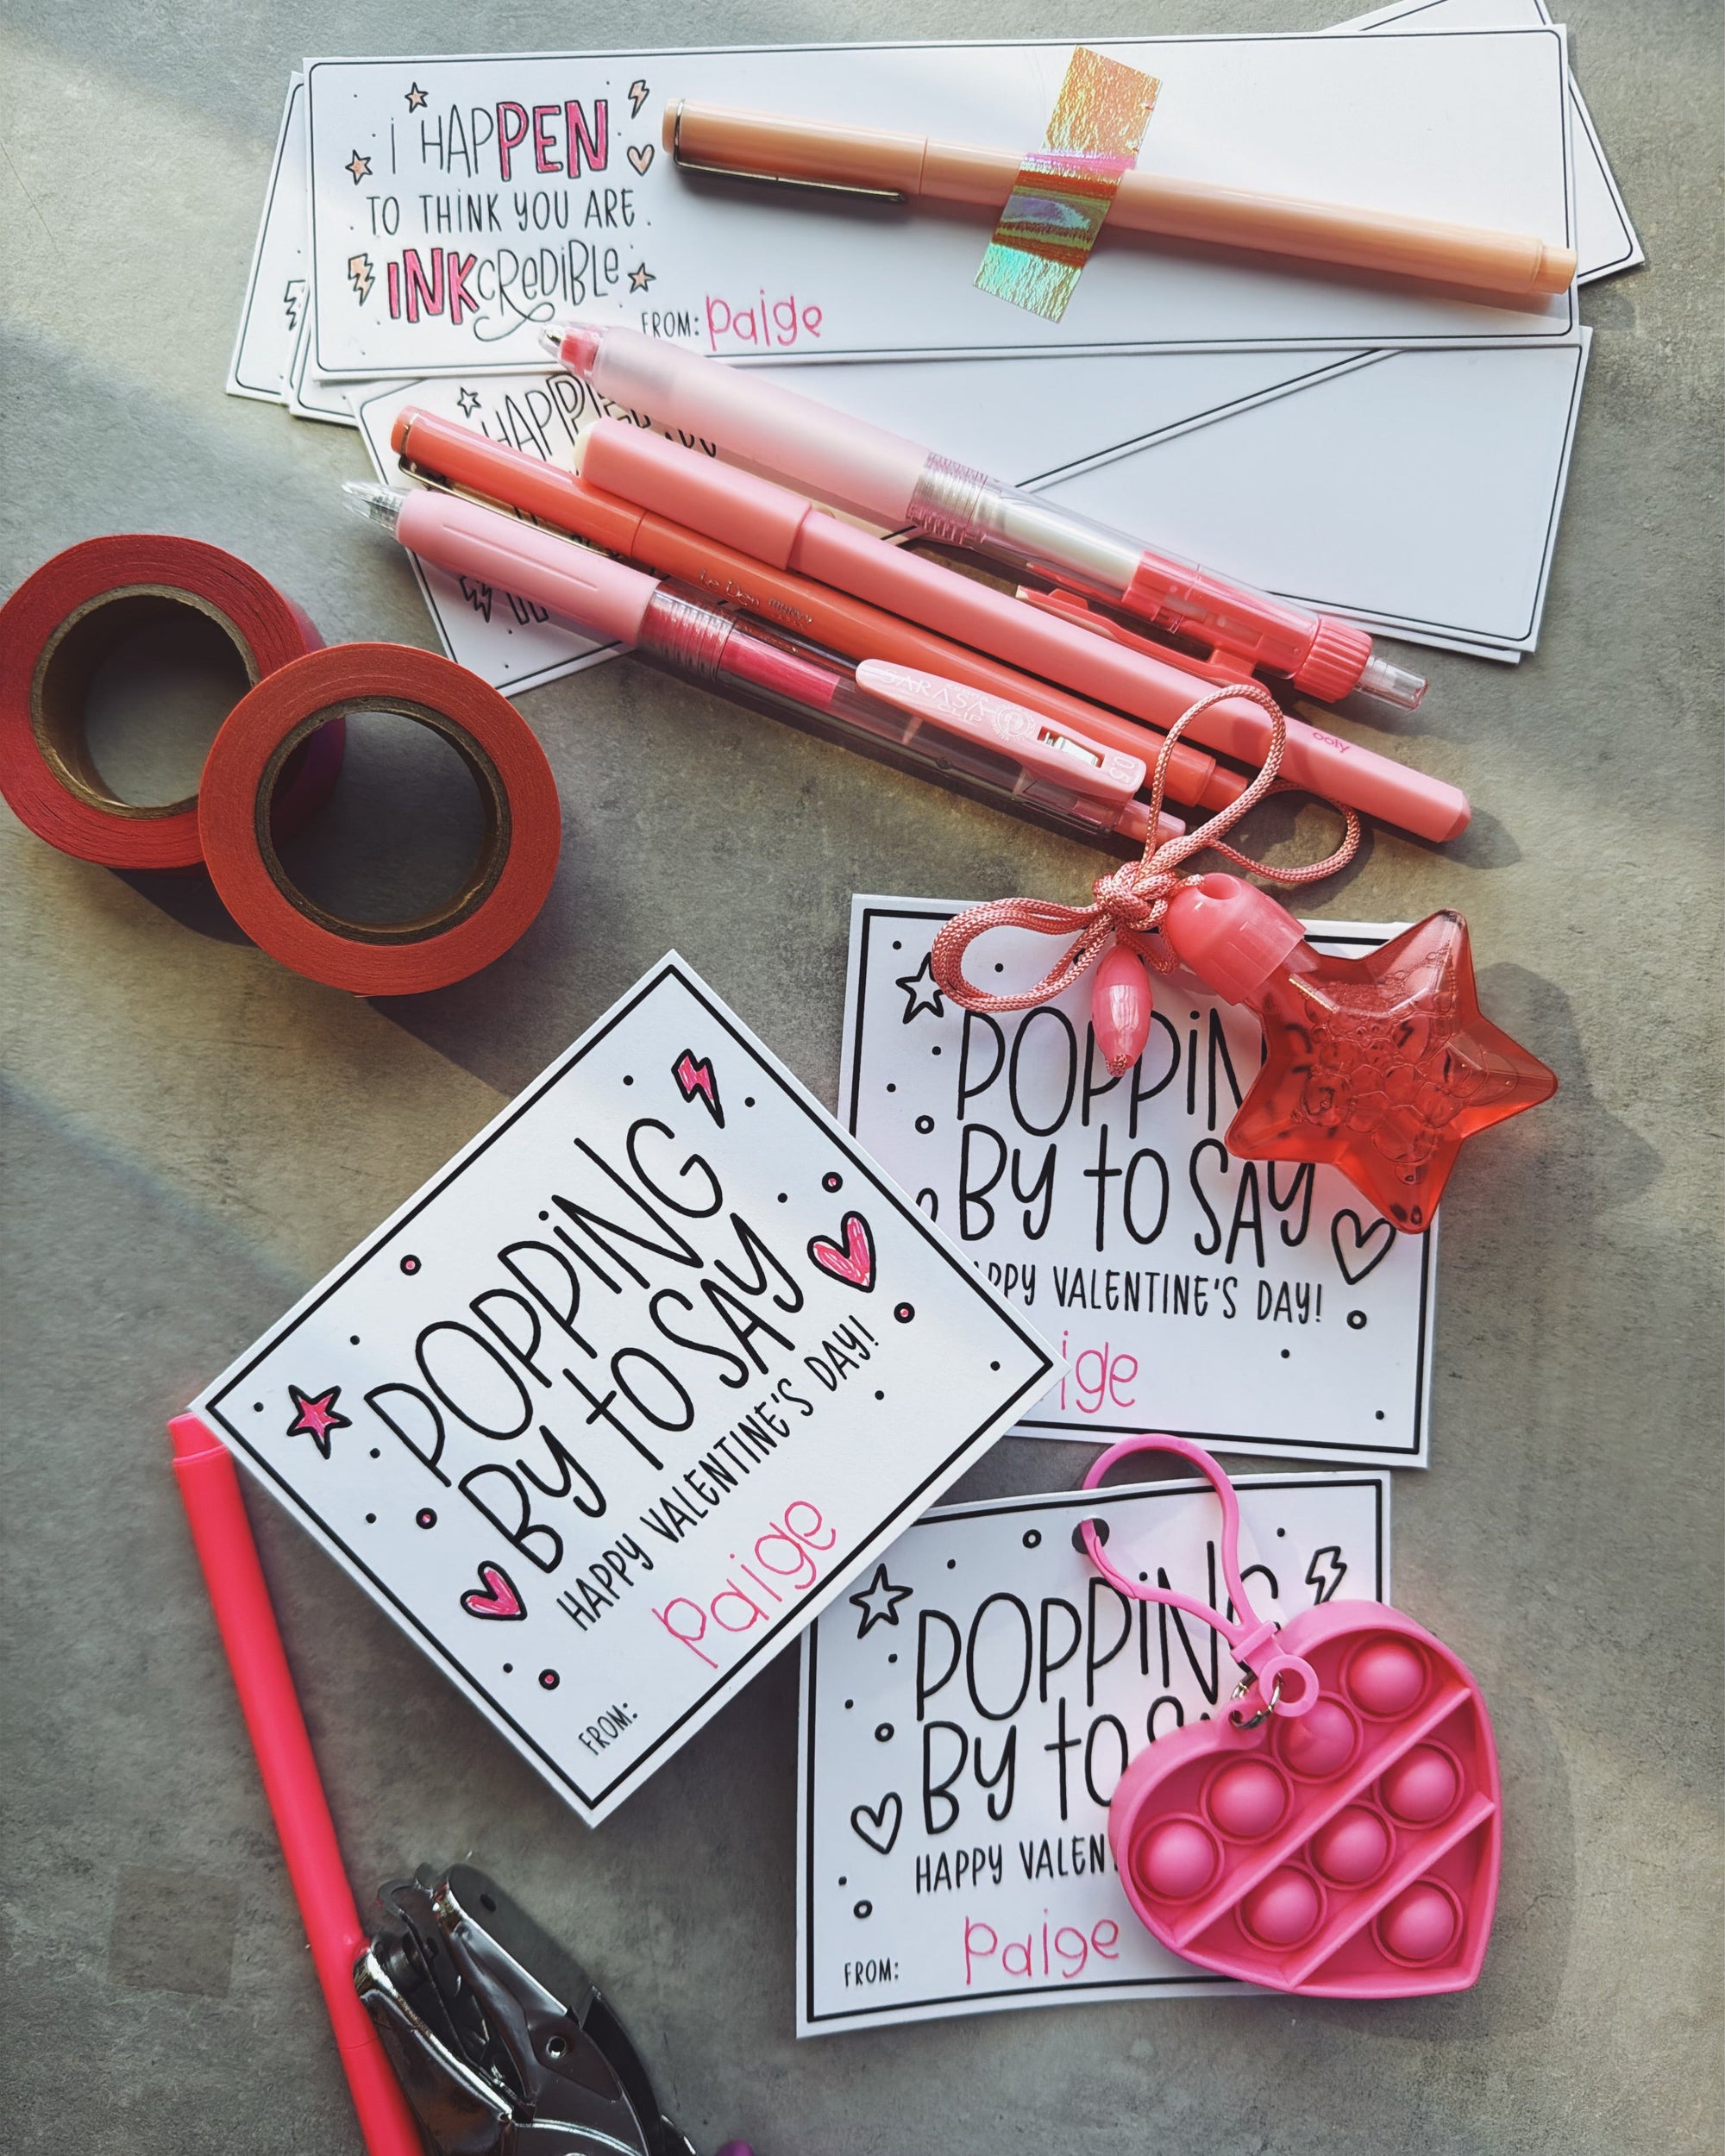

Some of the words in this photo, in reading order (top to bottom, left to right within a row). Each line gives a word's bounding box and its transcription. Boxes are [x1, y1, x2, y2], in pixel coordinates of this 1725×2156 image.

[420, 98, 609, 182] HAPPEN
[366, 195, 400, 236] TO
[514, 190, 568, 232] YOU
[584, 188, 636, 229] ARE
[641, 311, 700, 339] FROM:
[881, 668, 985, 717] SARASA
[938, 703, 983, 724] CLIP
[1312, 732, 1351, 754] ooly
[1108, 755, 1136, 784] 0.5
[649, 1213, 804, 1389] SAY
[1053, 1265, 1238, 1319] VALENTINE'S
[1256, 1280, 1322, 1325] DAY!
[556, 1533, 654, 1632] HAPPY
[640, 1378, 813, 1543] VALENTINE'S
[805, 1315, 879, 1391] DAY!
[578, 1703, 638, 1756] FROM:
[916, 1843, 1003, 1895] HAPPY
[844, 1958, 899, 1988] FROM:
